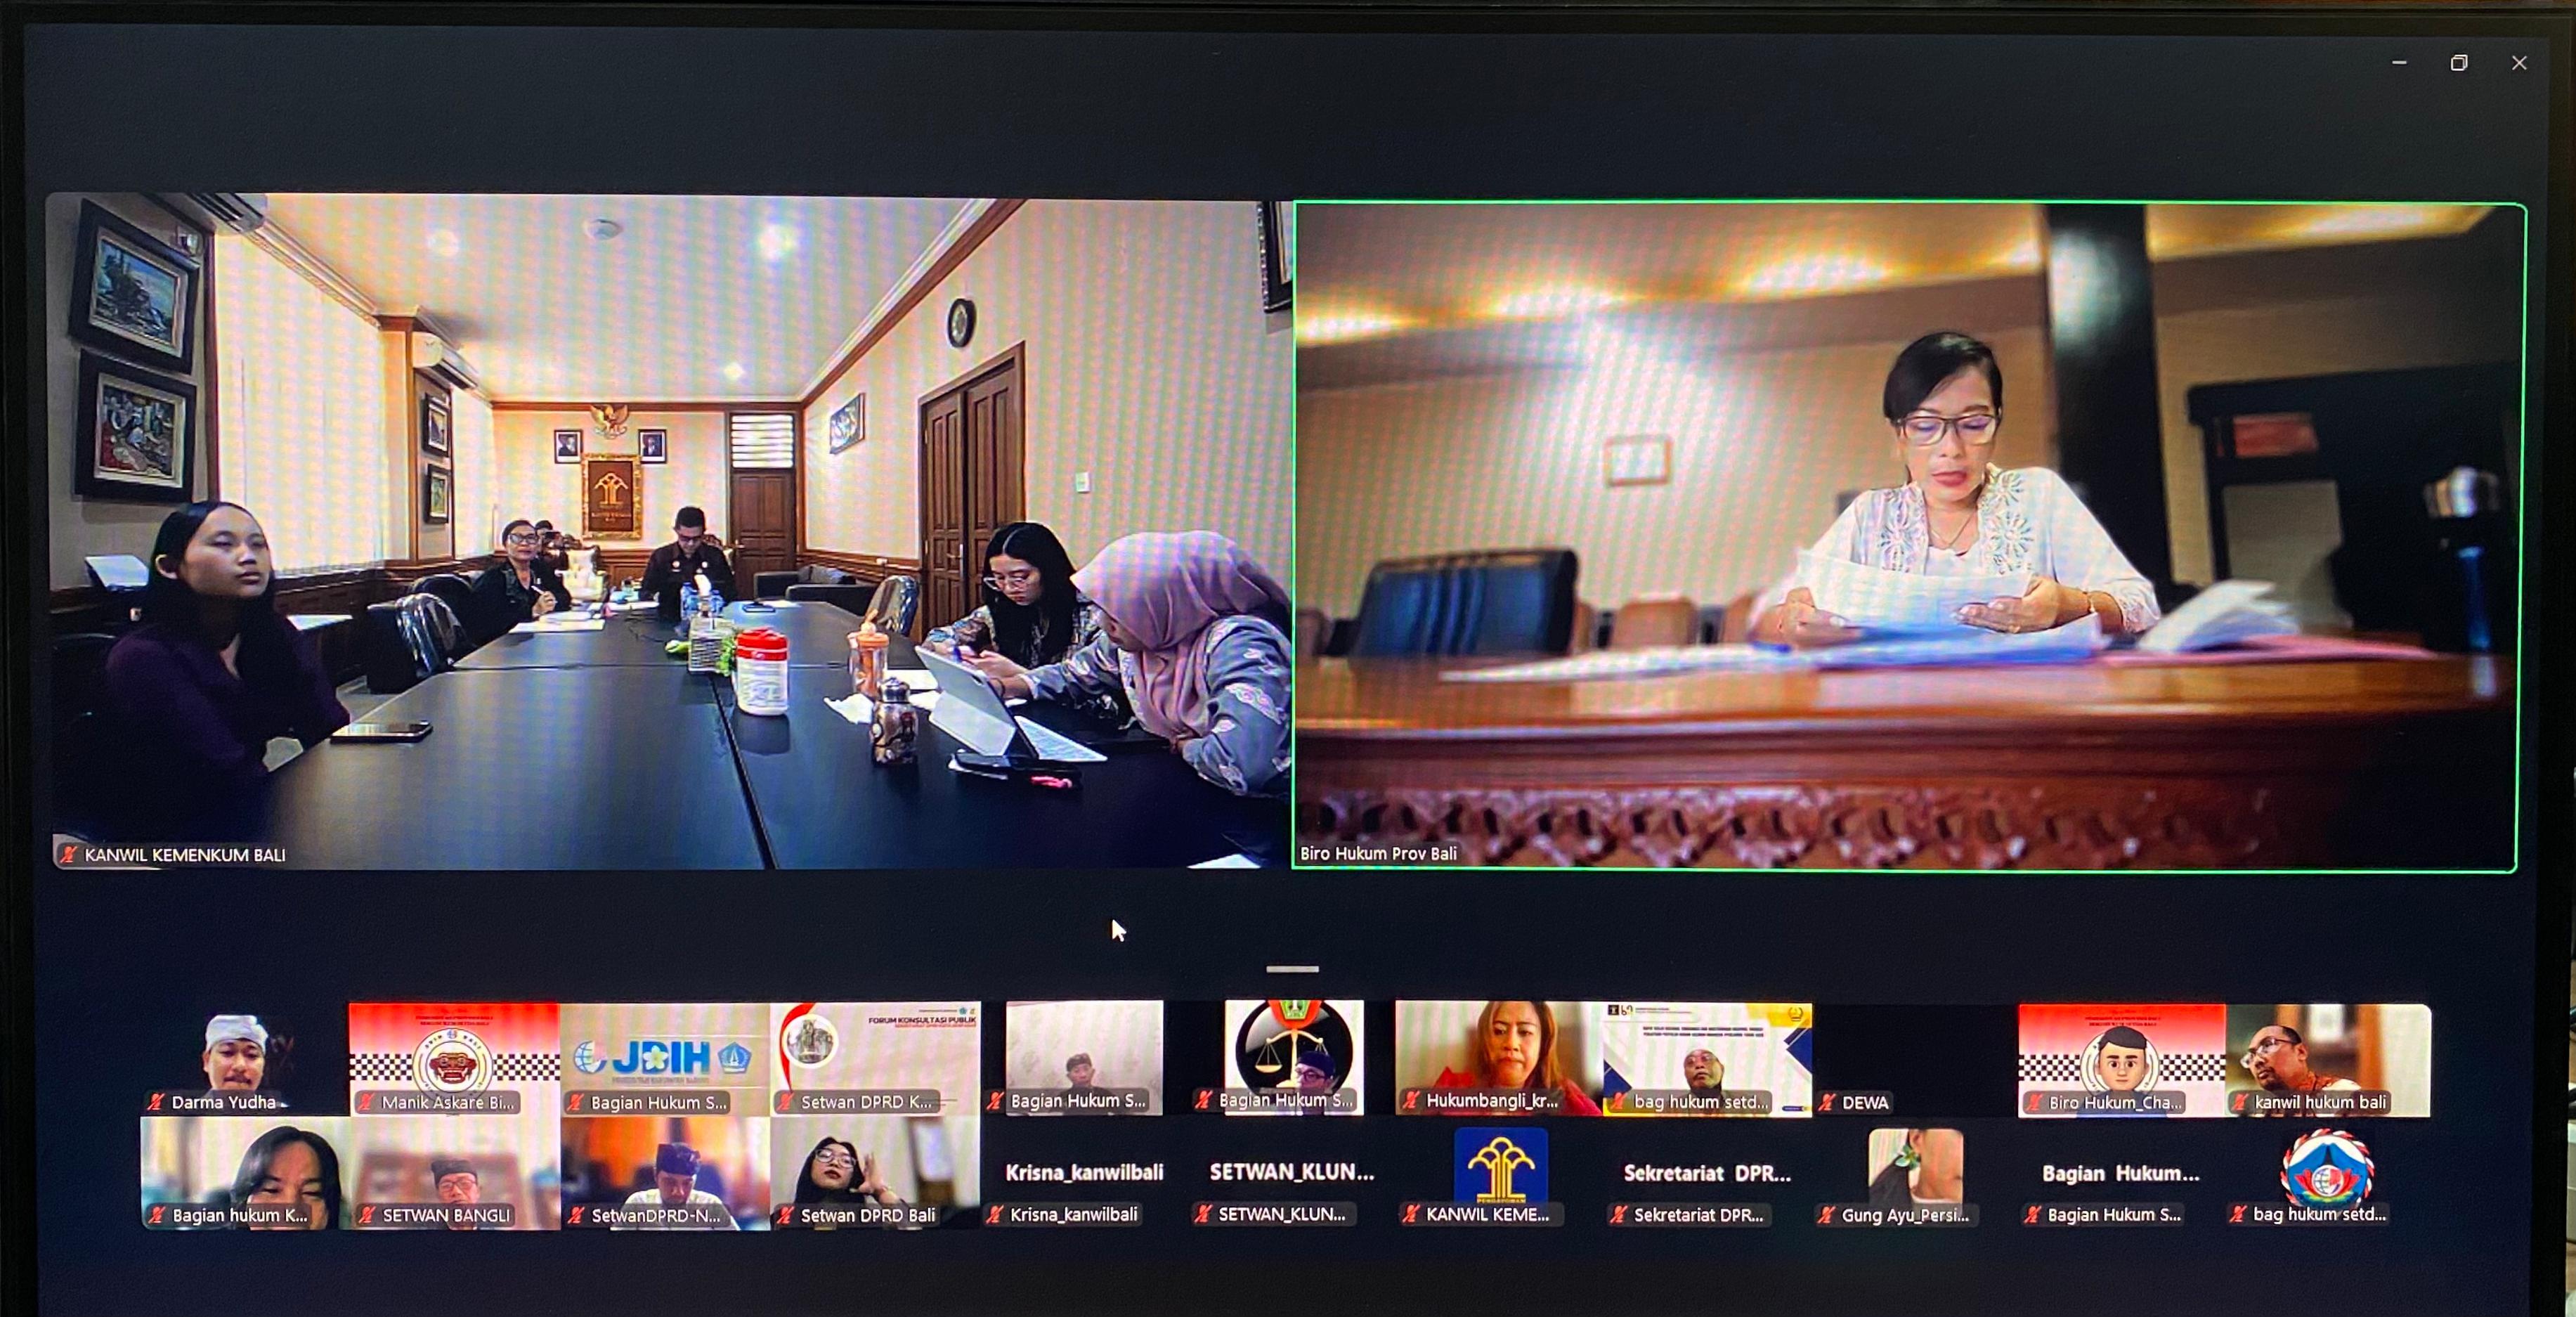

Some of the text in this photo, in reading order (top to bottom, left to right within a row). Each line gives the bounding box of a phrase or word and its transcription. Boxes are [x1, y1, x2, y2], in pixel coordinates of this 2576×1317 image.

[85, 848, 286, 862] KANWIL KEMENKUM BALI
[1301, 845, 1457, 861] Biro Hukum Prov Bali
[172, 1095, 277, 1110] Darma Yudha
[382, 1096, 514, 1110] Manik Askare Bi...
[591, 1096, 727, 1114] Bagian Hukum S...
[801, 1094, 932, 1110] Setwan DPRD K...
[1011, 1094, 1146, 1112] Bagian Hukum S...
[1219, 1093, 1353, 1112] Bagian Hukum S...
[1634, 1094, 1769, 1112] bag hukum setd...
[1842, 1096, 1889, 1110] DEWA
[2049, 1096, 2182, 1113] Biro Hukum_Cha...
[2255, 1095, 2387, 1110] kanwil hukum bali
[1006, 1163, 1164, 1183] Krisna_kanwilbali
[1210, 1163, 1375, 1183] SETWAN_KLUN...
[1625, 1164, 1791, 1182] Sekretariat DPR...
[2043, 1164, 2200, 1186] Bagian Hukum...
[173, 1208, 308, 1226] Bagian hukum K...
[383, 1209, 510, 1224] SETWAN BANGLI
[592, 1208, 721, 1224] SetwanDPRD-N...
[801, 1208, 936, 1224] Setwan DPRD Bali
[1010, 1207, 1138, 1225] Krisna_kanwilbali
[1219, 1207, 1346, 1225] SETWAN_KLUN...
[1426, 1207, 1549, 1223] KANWIL KEME...
[1634, 1207, 1764, 1224] Sekretariat DPR...
[1842, 1208, 1970, 1226] Gung Ayu_Persi...
[2048, 1208, 2181, 1226] Bagian Hukum S...
[2253, 1207, 2386, 1226] bag hukum setd...
